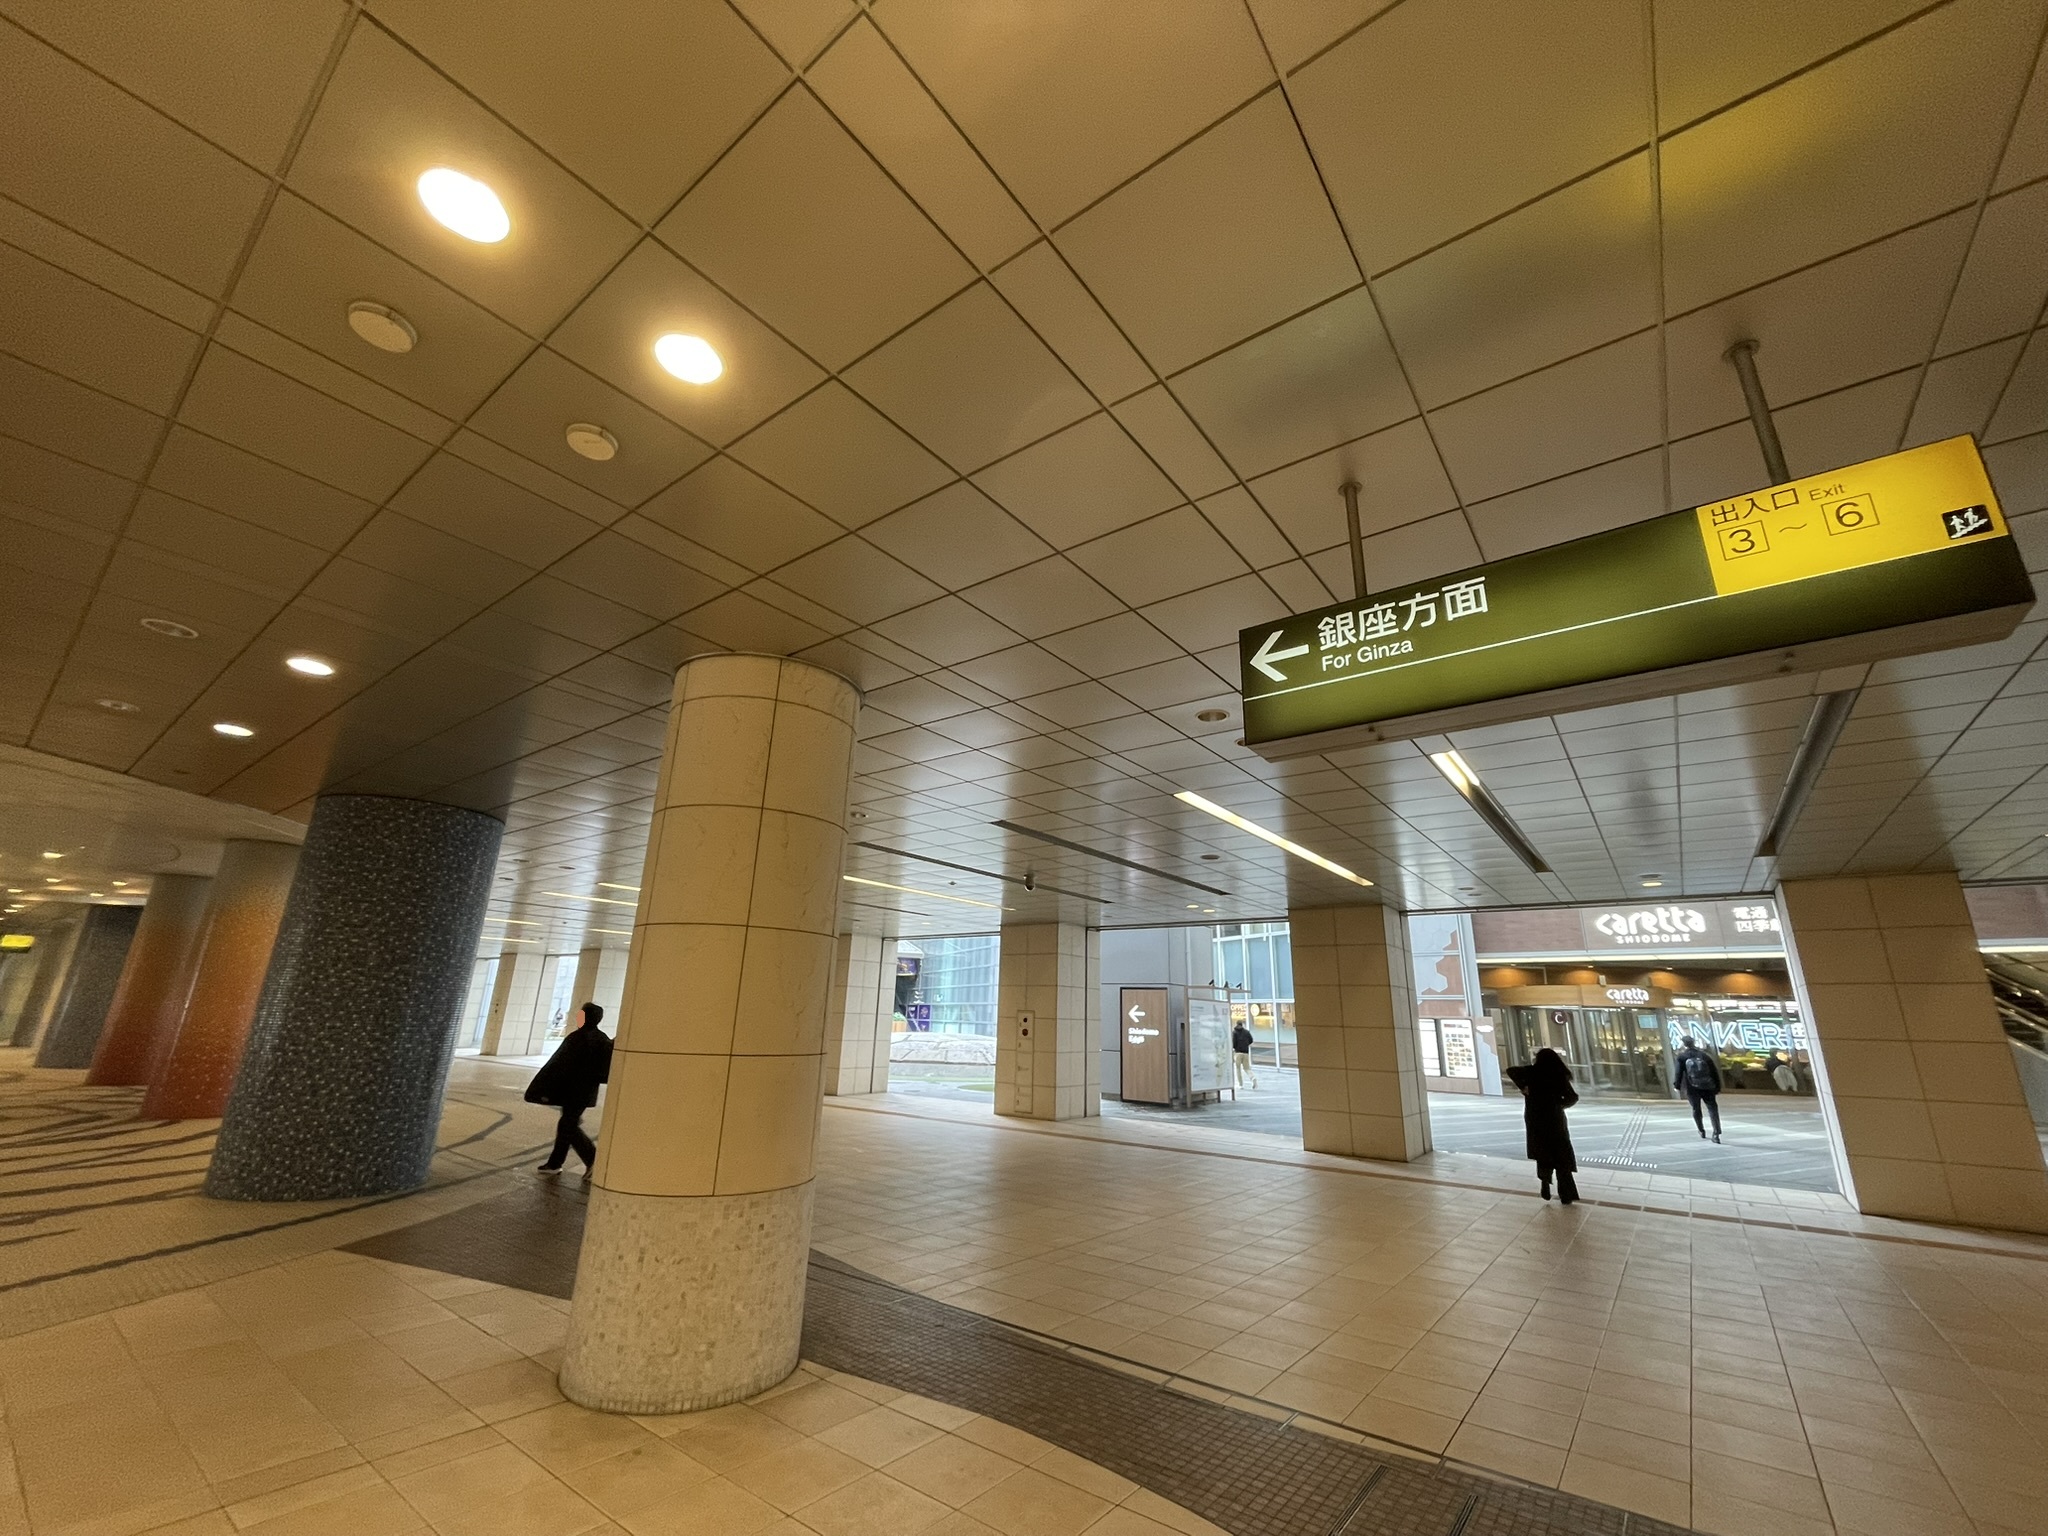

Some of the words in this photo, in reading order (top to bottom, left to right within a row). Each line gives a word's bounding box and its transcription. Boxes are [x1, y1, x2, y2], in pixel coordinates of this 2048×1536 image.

[1711, 488, 1800, 527] 出入口
[1808, 483, 1846, 501] Exit
[1731, 528, 1757, 554] 3
[1835, 502, 1865, 528] 6
[1317, 576, 1489, 651] 銀座方面
[1322, 652, 1352, 672] For
[1357, 639, 1414, 664] Ginza
[1596, 906, 1707, 936] caretta
[1615, 933, 1691, 944] SHIODOME
[1606, 987, 1650, 1001] caretta
